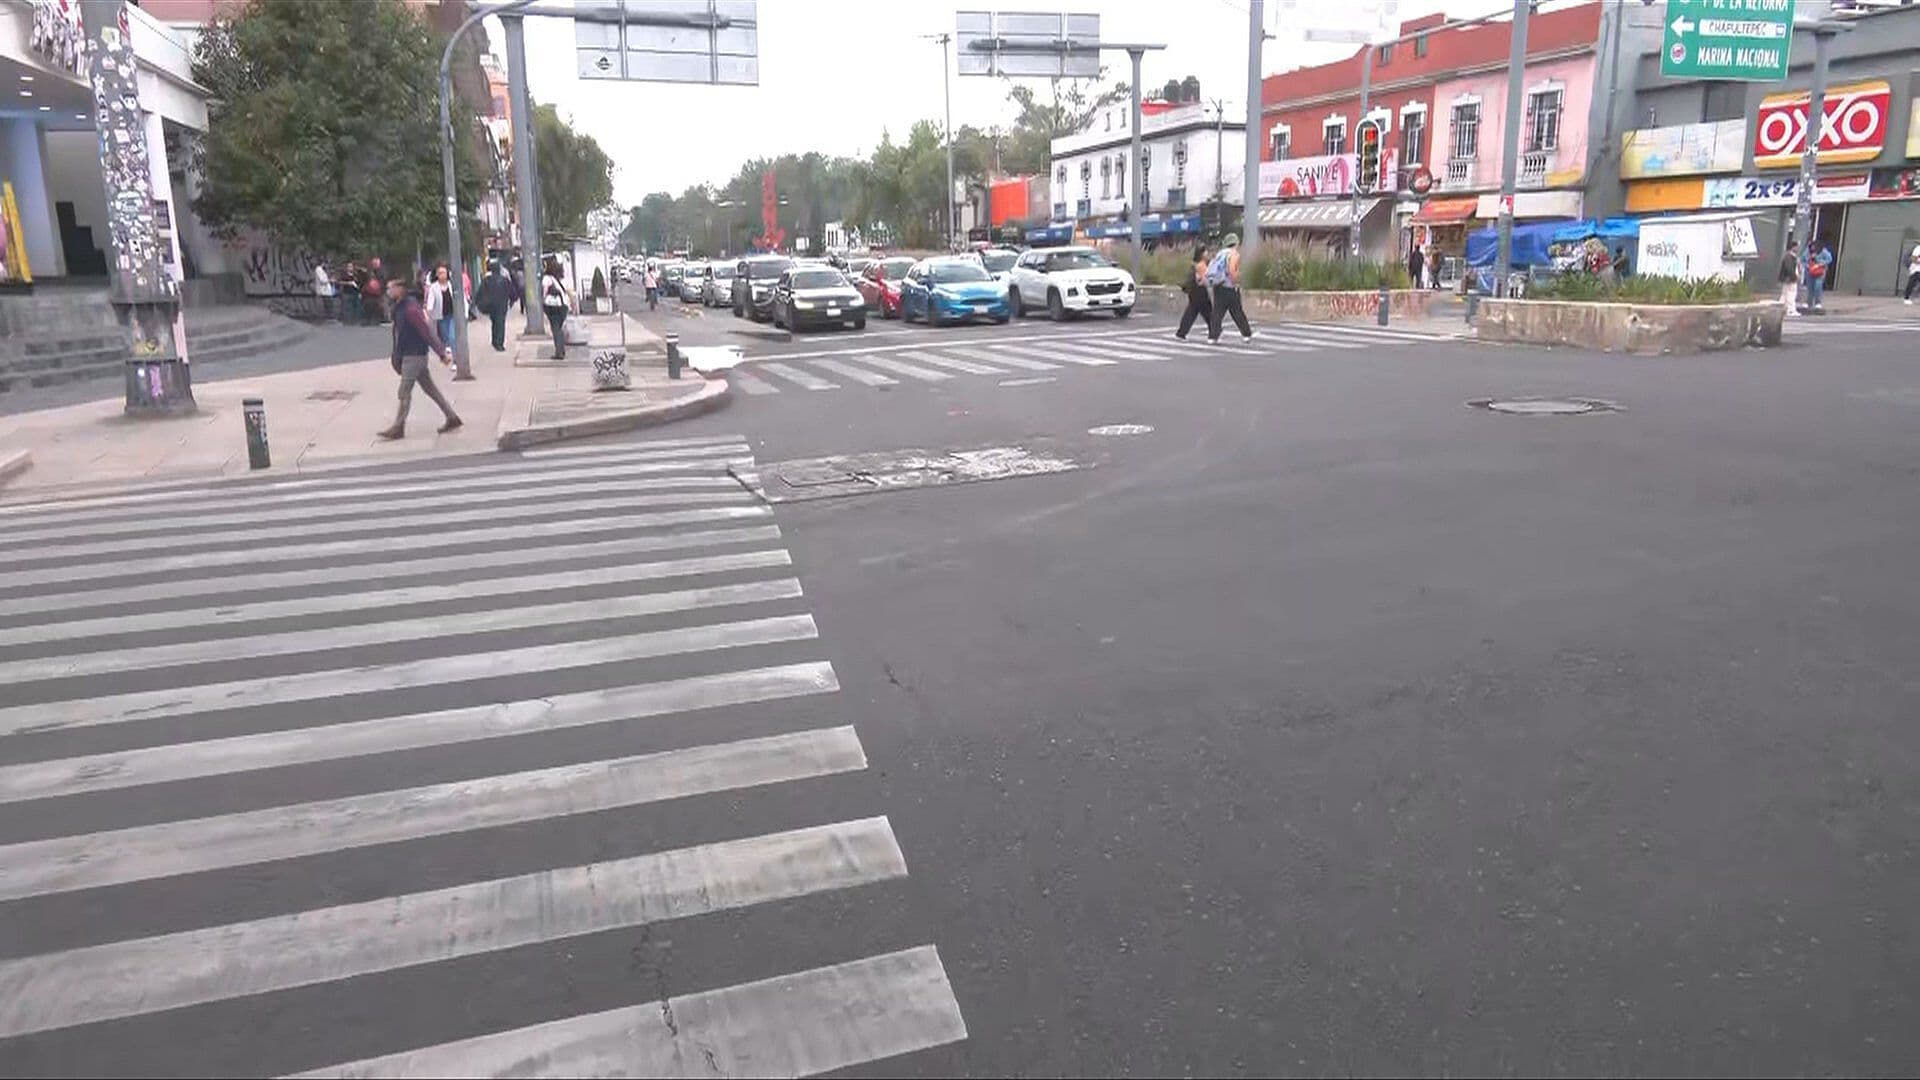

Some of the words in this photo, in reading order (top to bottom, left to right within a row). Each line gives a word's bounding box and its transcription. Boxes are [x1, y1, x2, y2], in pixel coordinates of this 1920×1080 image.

[1709, 22, 1767, 35] CHAPULTEPEC
[1697, 46, 1732, 66] MARINA
[1736, 48, 1780, 68] NACIONAL
[1759, 97, 1879, 155] OXXO
